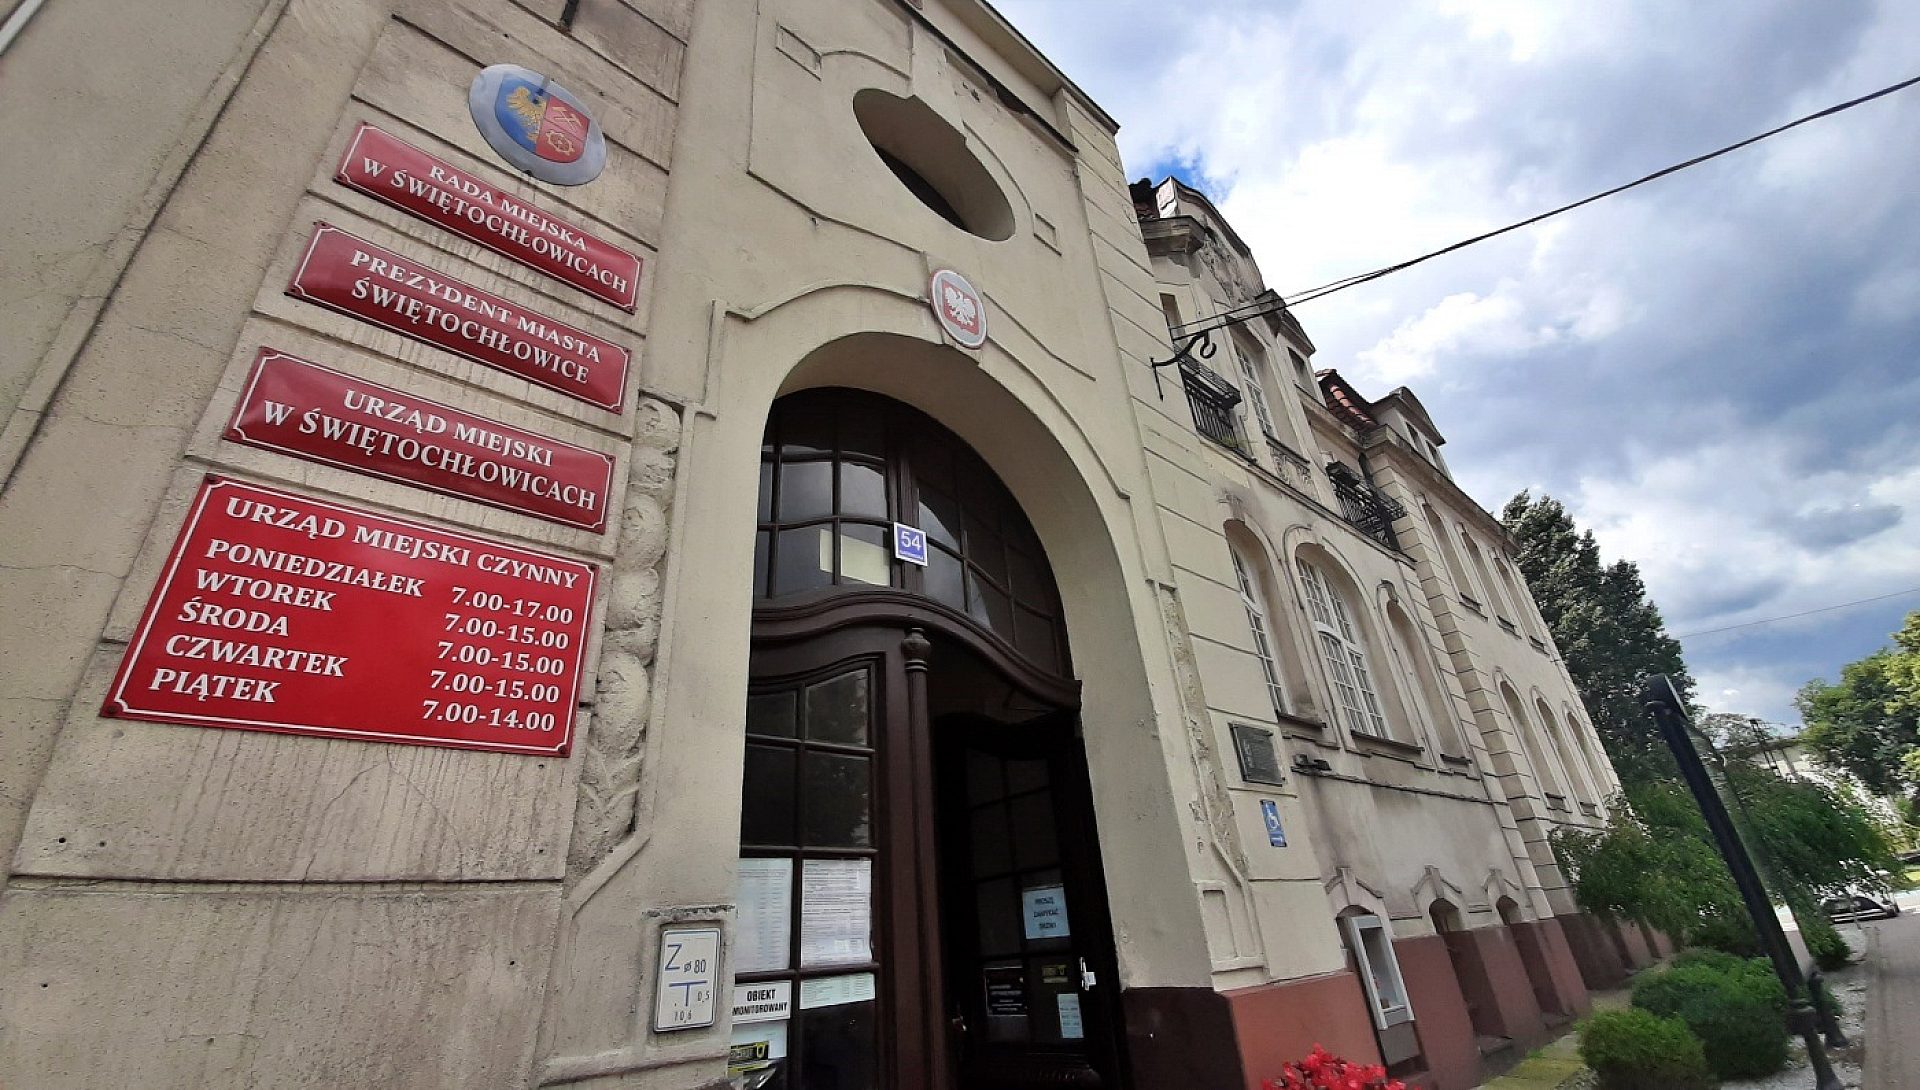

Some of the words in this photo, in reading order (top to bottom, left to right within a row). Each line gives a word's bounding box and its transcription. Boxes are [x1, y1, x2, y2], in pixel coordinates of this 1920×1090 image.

[363, 158, 387, 178] W
[390, 170, 628, 294] ŚWIĘTOCHŁOWICACH
[430, 165, 494, 205] RADA
[501, 199, 588, 251] MIEJSKA
[350, 249, 513, 324] PREZYDENT
[517, 316, 600, 364] MIASTA
[352, 277, 590, 385] ŚWIĘTOCHŁOWICE
[263, 400, 294, 427] W
[299, 408, 597, 512] ŚWIĘTOCHŁOWICACH
[343, 389, 448, 436] URZĄD
[453, 422, 553, 467] MIEJSKI
[204, 538, 426, 598] PONIEDZIAŁEK
[451, 586, 574, 625] 7.00-17.00
[224, 497, 346, 541] URZĄD
[354, 526, 470, 567] MIEJSKI
[477, 553, 579, 590] CZYNNY
[901, 530, 922, 551] 54
[177, 596, 289, 637] ŚRODA
[436, 641, 565, 677] 7.00-15.00
[196, 568, 336, 612] WTOREK
[444, 613, 569, 651] 7.00-15.00
[149, 668, 282, 703] PIĄTEK
[421, 699, 556, 733] 7.00-14.00
[164, 634, 348, 678] CZWARTEK
[430, 670, 560, 703] 7.00-15.00
[665, 944, 682, 971] Z
[746, 989, 776, 1002] OBIEKT
[732, 1001, 788, 1016] MONITOROWANY
